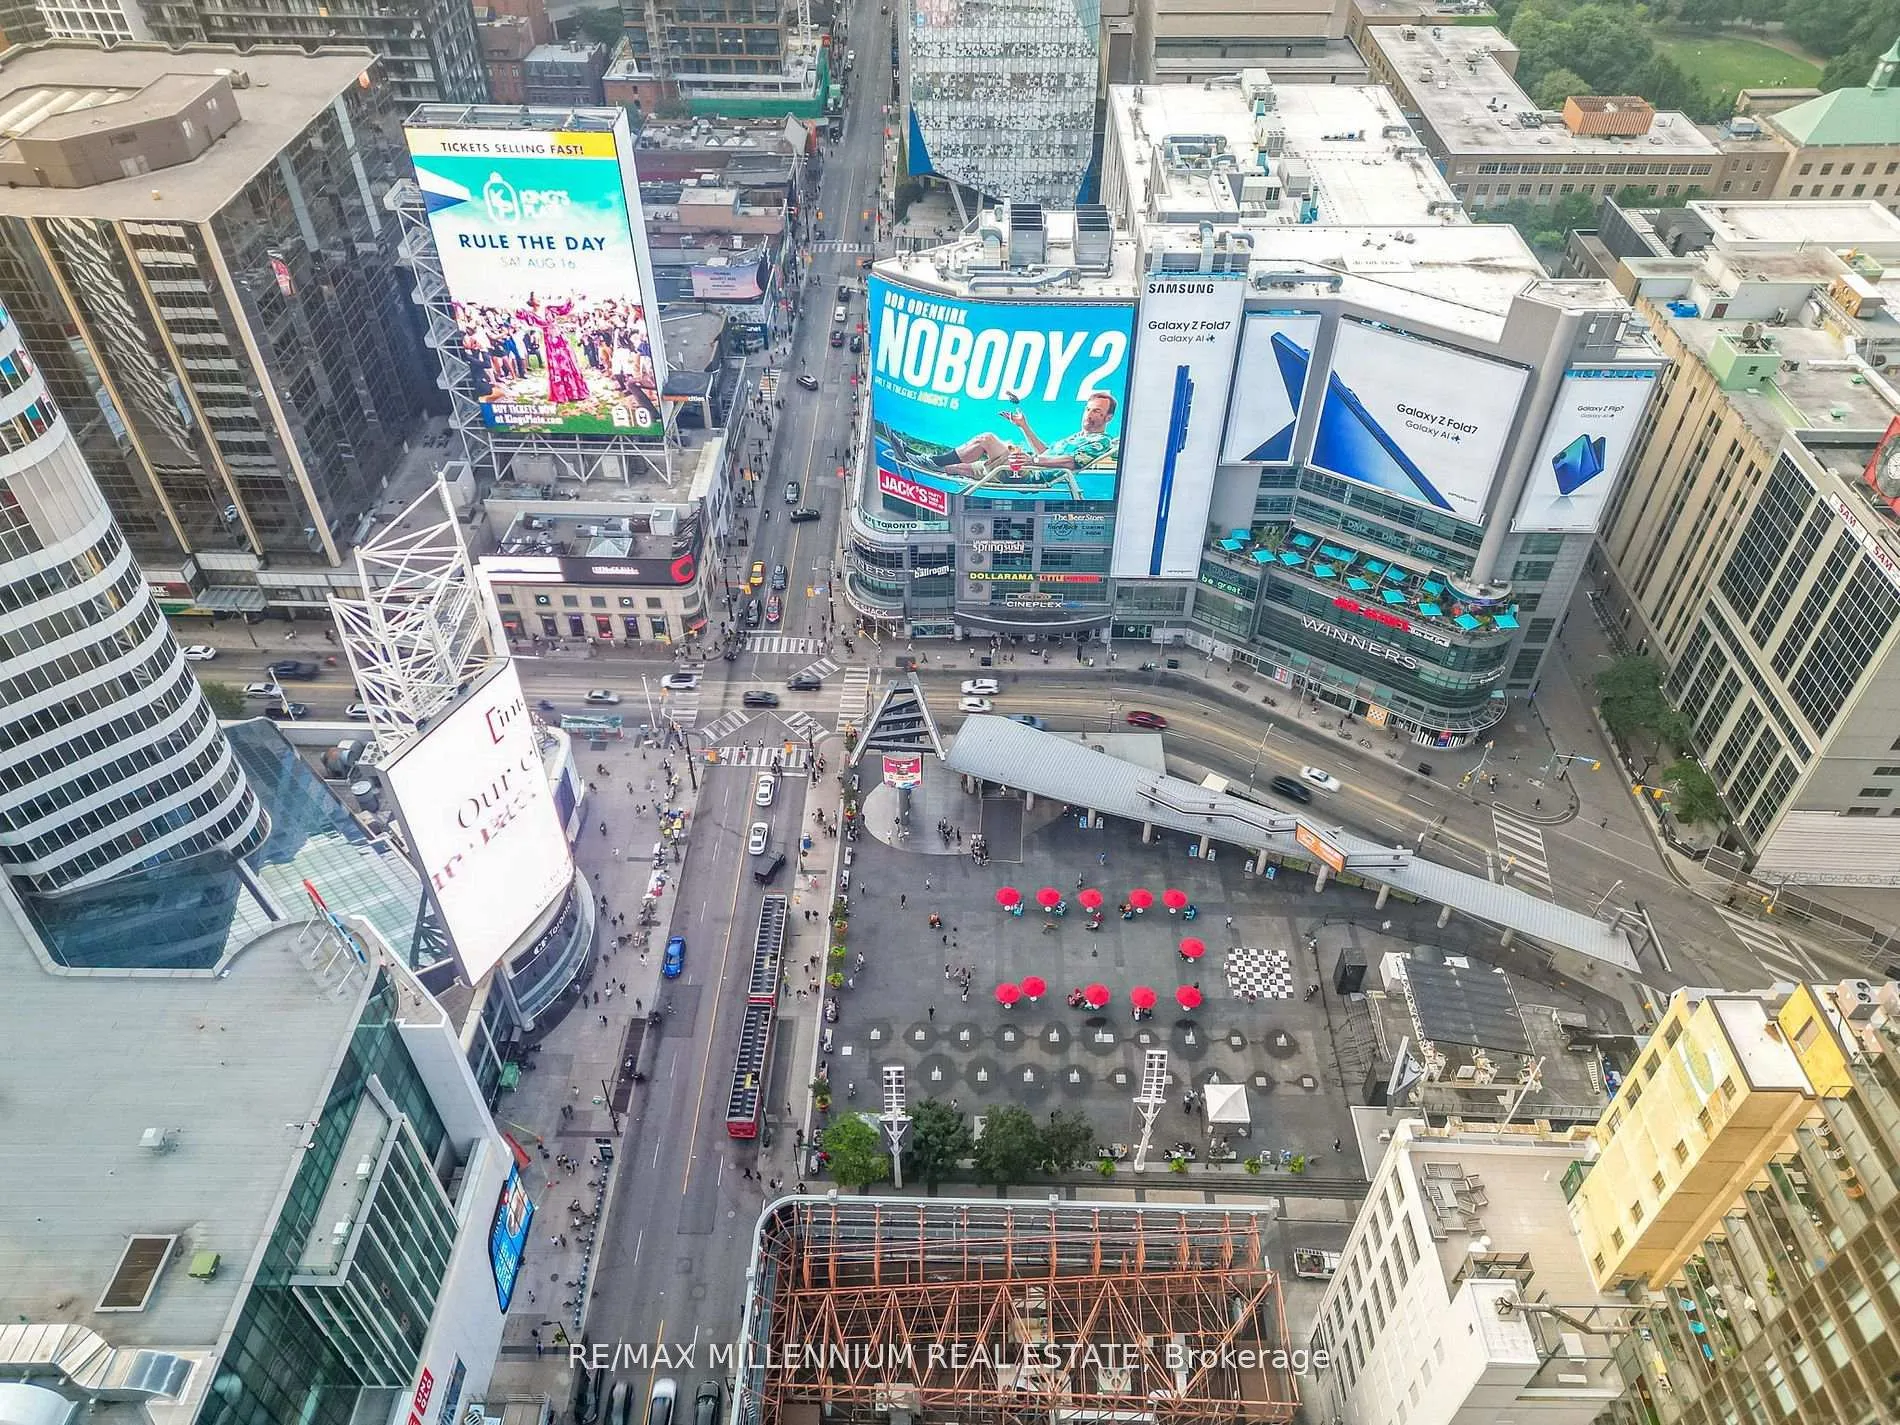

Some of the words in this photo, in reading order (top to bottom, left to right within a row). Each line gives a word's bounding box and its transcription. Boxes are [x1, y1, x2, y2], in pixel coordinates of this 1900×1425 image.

[440, 142, 490, 153] TICKETS
[495, 143, 545, 154] SELLING
[550, 145, 584, 155] FAST!
[459, 233, 509, 249] RULE
[518, 235, 556, 250] THE
[565, 236, 606, 251] DAY
[528, 257, 556, 269] AUG
[1148, 283, 1216, 294] SAMSUNG
[907, 298, 968, 325] ODENKIRK
[1148, 321, 1190, 332] Galaxy
[1191, 321, 1199, 330] Z
[1200, 320, 1231, 330] Fold7
[1159, 334, 1194, 344] Galaxy
[876, 306, 1089, 401] NOBODY
[1075, 330, 1128, 401] 2
[1396, 403, 1438, 424] Galaxy
[1438, 416, 1446, 426] Z
[1447, 418, 1478, 434] Fold7
[1405, 420, 1440, 437] Galaxy
[881, 475, 928, 503] JACK'S
[877, 520, 918, 529] TORONTO
[969, 572, 1034, 581] DOLLARAMA
[1302, 615, 1418, 670] WINNERS
